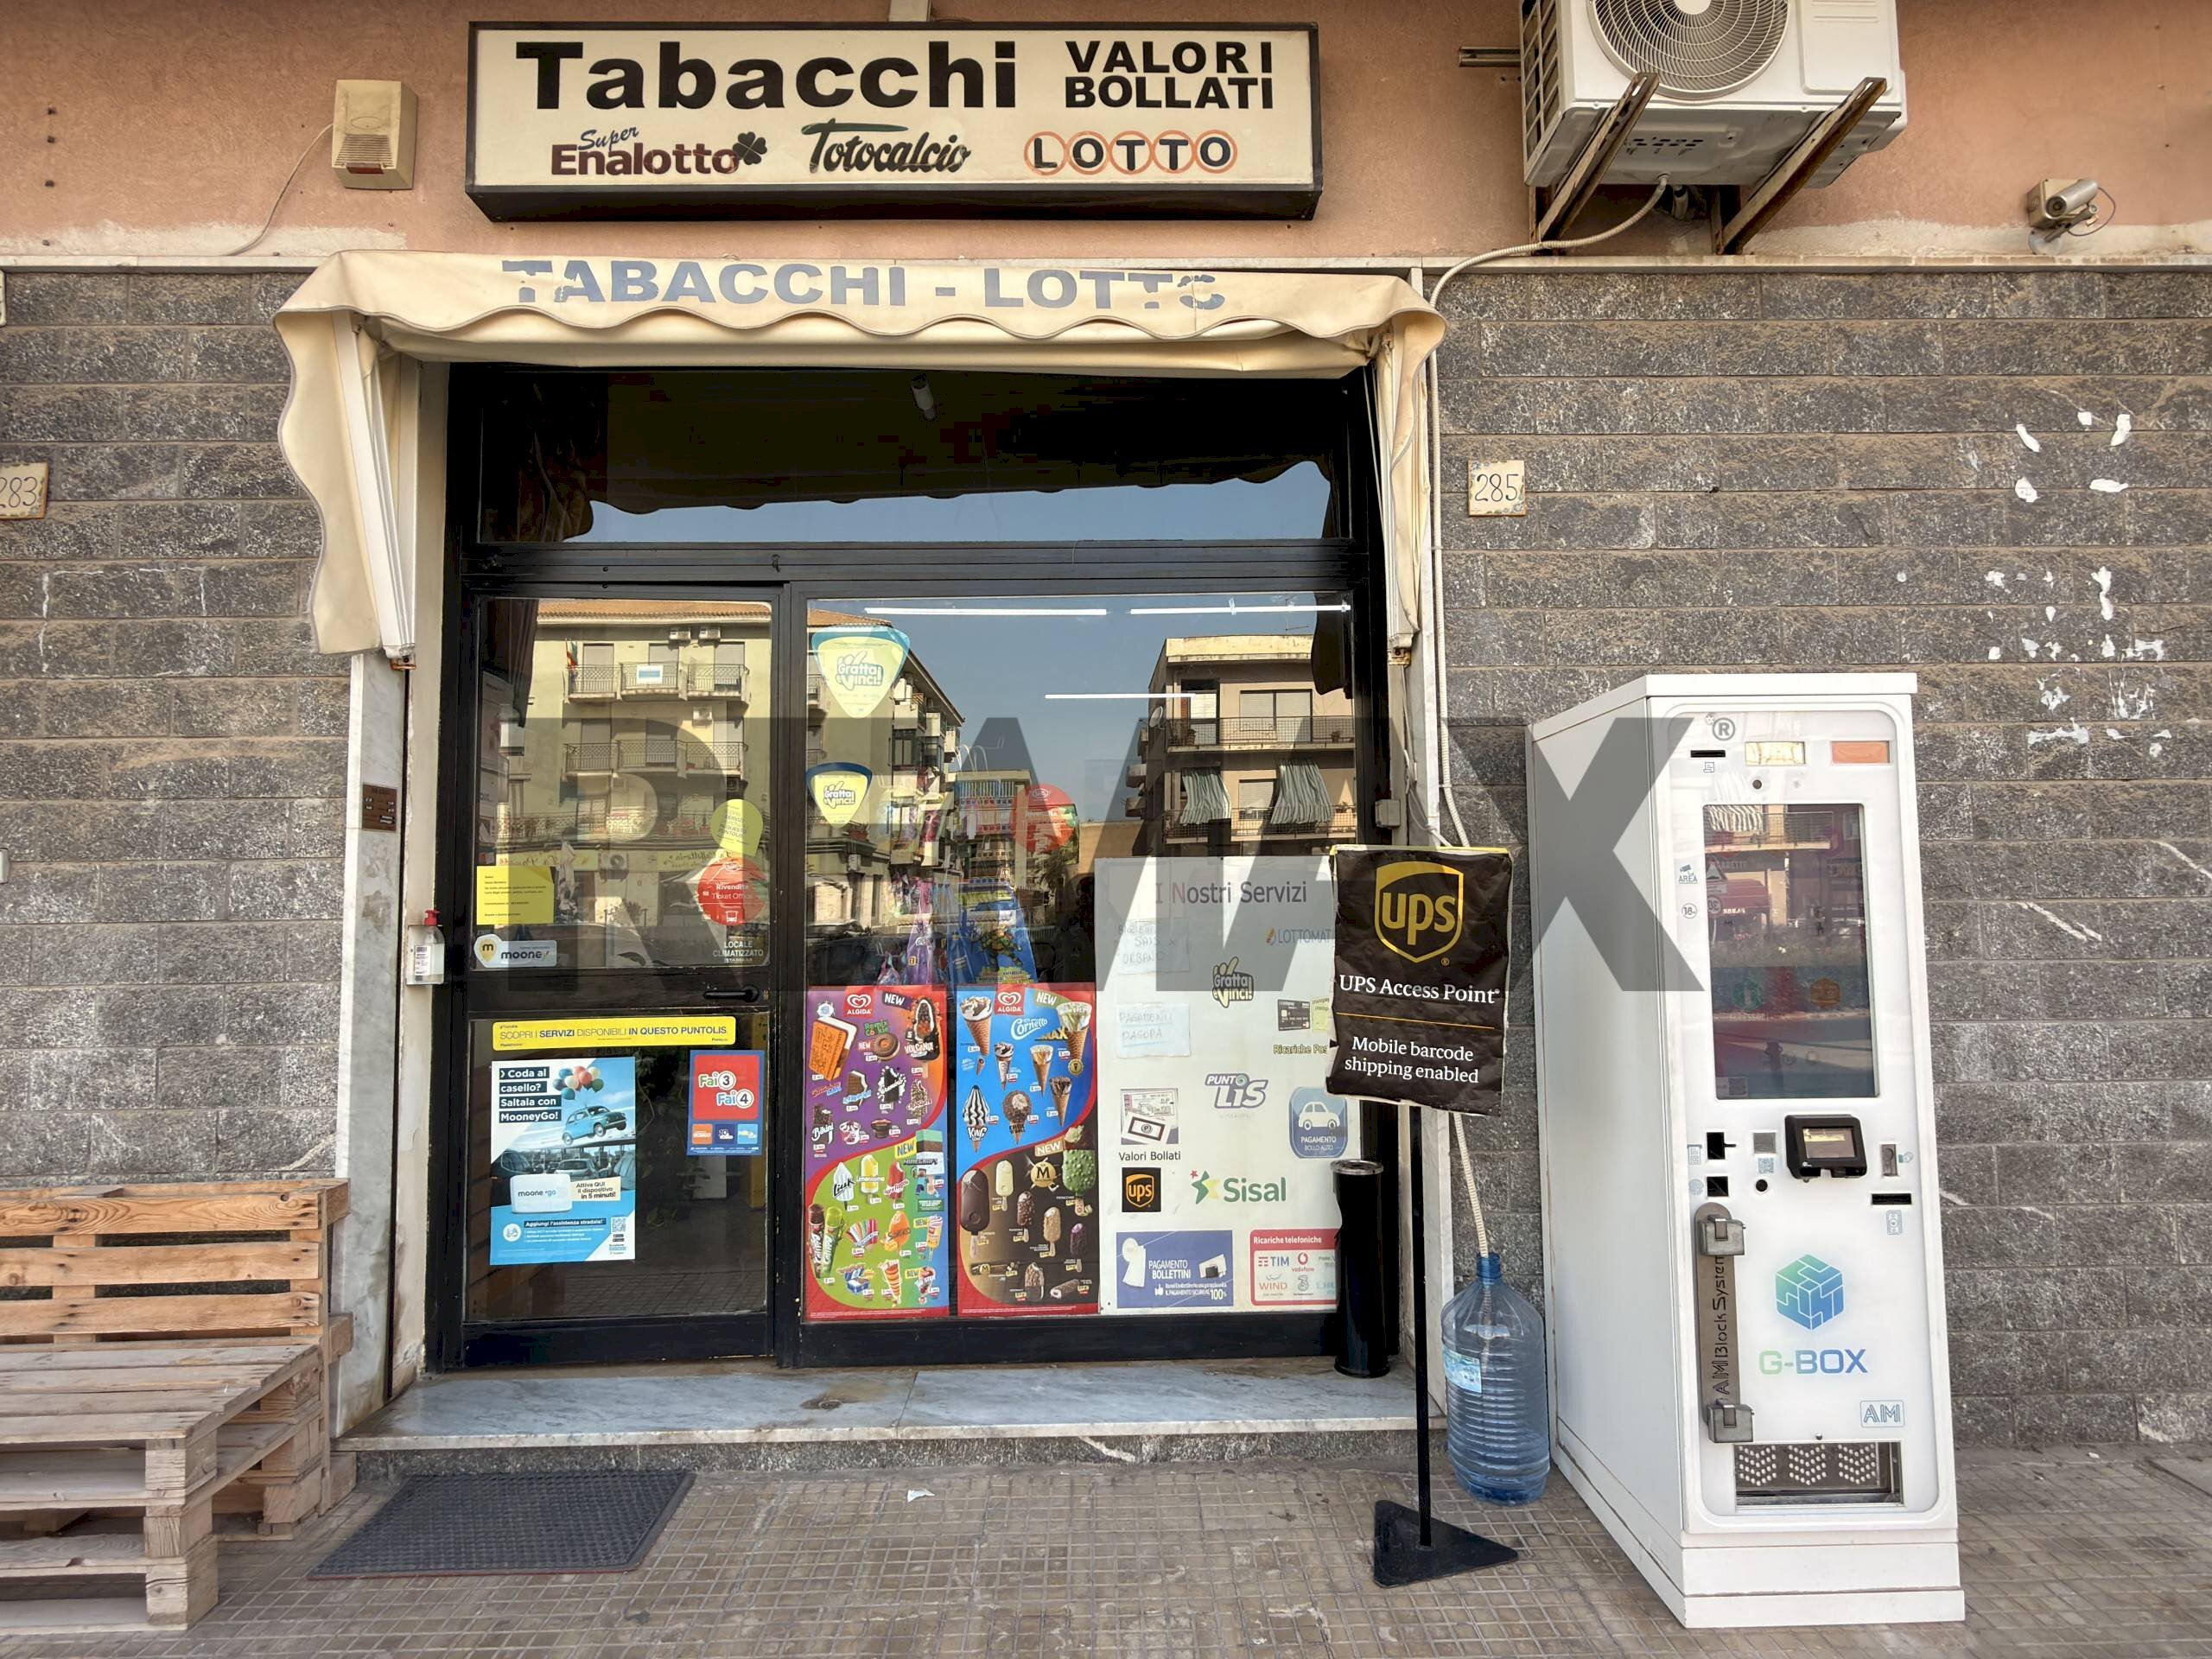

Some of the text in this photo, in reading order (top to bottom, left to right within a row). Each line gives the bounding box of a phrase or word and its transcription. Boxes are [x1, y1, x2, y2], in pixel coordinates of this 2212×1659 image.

[1065, 41, 1273, 74] VALORI
[516, 41, 1016, 110] Tabacchi
[1065, 76, 1274, 110] BOLLATI
[579, 124, 639, 152] Super
[801, 119, 973, 174] Totocalcio
[1033, 134, 1231, 172] LOTTO
[551, 139, 739, 176] Enalotto
[502, 259, 906, 308] TABACCHI
[1474, 474, 1519, 502] 285
[837, 663, 878, 674] Gratta
[1172, 881, 1231, 904] Nostri
[1239, 880, 1307, 904] Servizi
[1382, 892, 1456, 946] ups
[1278, 928, 1334, 944] LOTTOMATI
[713, 949, 764, 957] CLIMATIZZATO
[1213, 973, 1249, 988] Gratta
[1339, 975, 1497, 1004] UPS Access Point
[884, 993, 906, 1006] NEW
[1036, 992, 1058, 1005] NEW
[500, 1030, 534, 1040] SCOPRI
[539, 1028, 575, 1039] SERVIZI
[576, 1027, 626, 1038] DISPONIBILI
[628, 1027, 639, 1036] IN
[639, 1027, 679, 1036] QUESTO
[681, 1025, 728, 1035] PUNTOLIS
[1011, 1018, 1048, 1040] Cornetto
[1273, 1043, 1313, 1055] Ricariche
[1352, 1036, 1474, 1062] Mobile barcode
[507, 1068, 547, 1078] Coda al
[1344, 1056, 1479, 1084] shipping enabled
[700, 1072, 718, 1087] Fai
[1207, 1074, 1248, 1085] PUNTO
[500, 1083, 542, 1093] casello?
[500, 1097, 536, 1107] Saltala
[717, 1090, 736, 1104] Fai
[500, 1111, 559, 1122] MooneyGo!
[897, 1141, 915, 1156] NEW
[1037, 1141, 1060, 1155] NEW
[1119, 1150, 1181, 1161] Valori Bollati
[1036, 1166, 1050, 1179] M
[1128, 1184, 1153, 1203] ups
[1224, 1176, 1287, 1203] Sisal
[1253, 1236, 1284, 1244] Ricariche
[1148, 1260, 1188, 1269] PAGAMENTO
[1270, 1255, 1290, 1267] TIM
[1152, 1268, 1192, 1280] BOLLETTINI
[1258, 1281, 1287, 1290] WIND
[1758, 1348, 1869, 1376] G-BOX
[1863, 1404, 1902, 1423] AM
